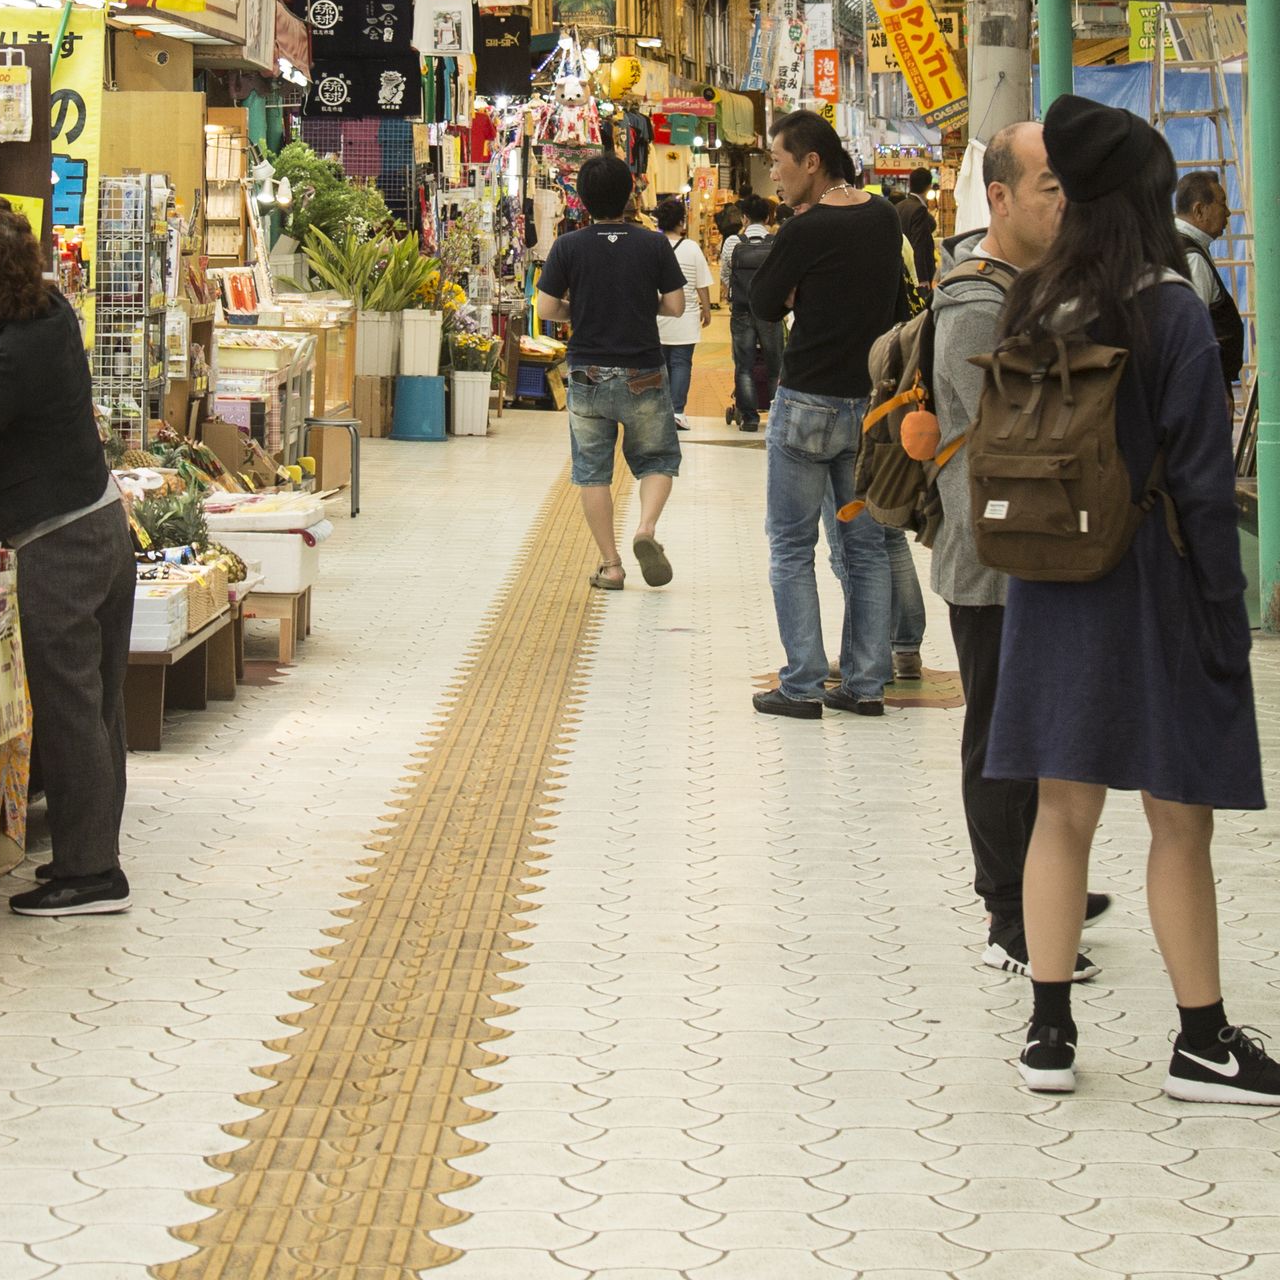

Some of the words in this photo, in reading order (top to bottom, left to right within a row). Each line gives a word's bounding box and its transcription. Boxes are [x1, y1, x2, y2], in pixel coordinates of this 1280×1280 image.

[816, 56, 836, 97] 泡盛
[900, 5, 953, 100] マンゴー
